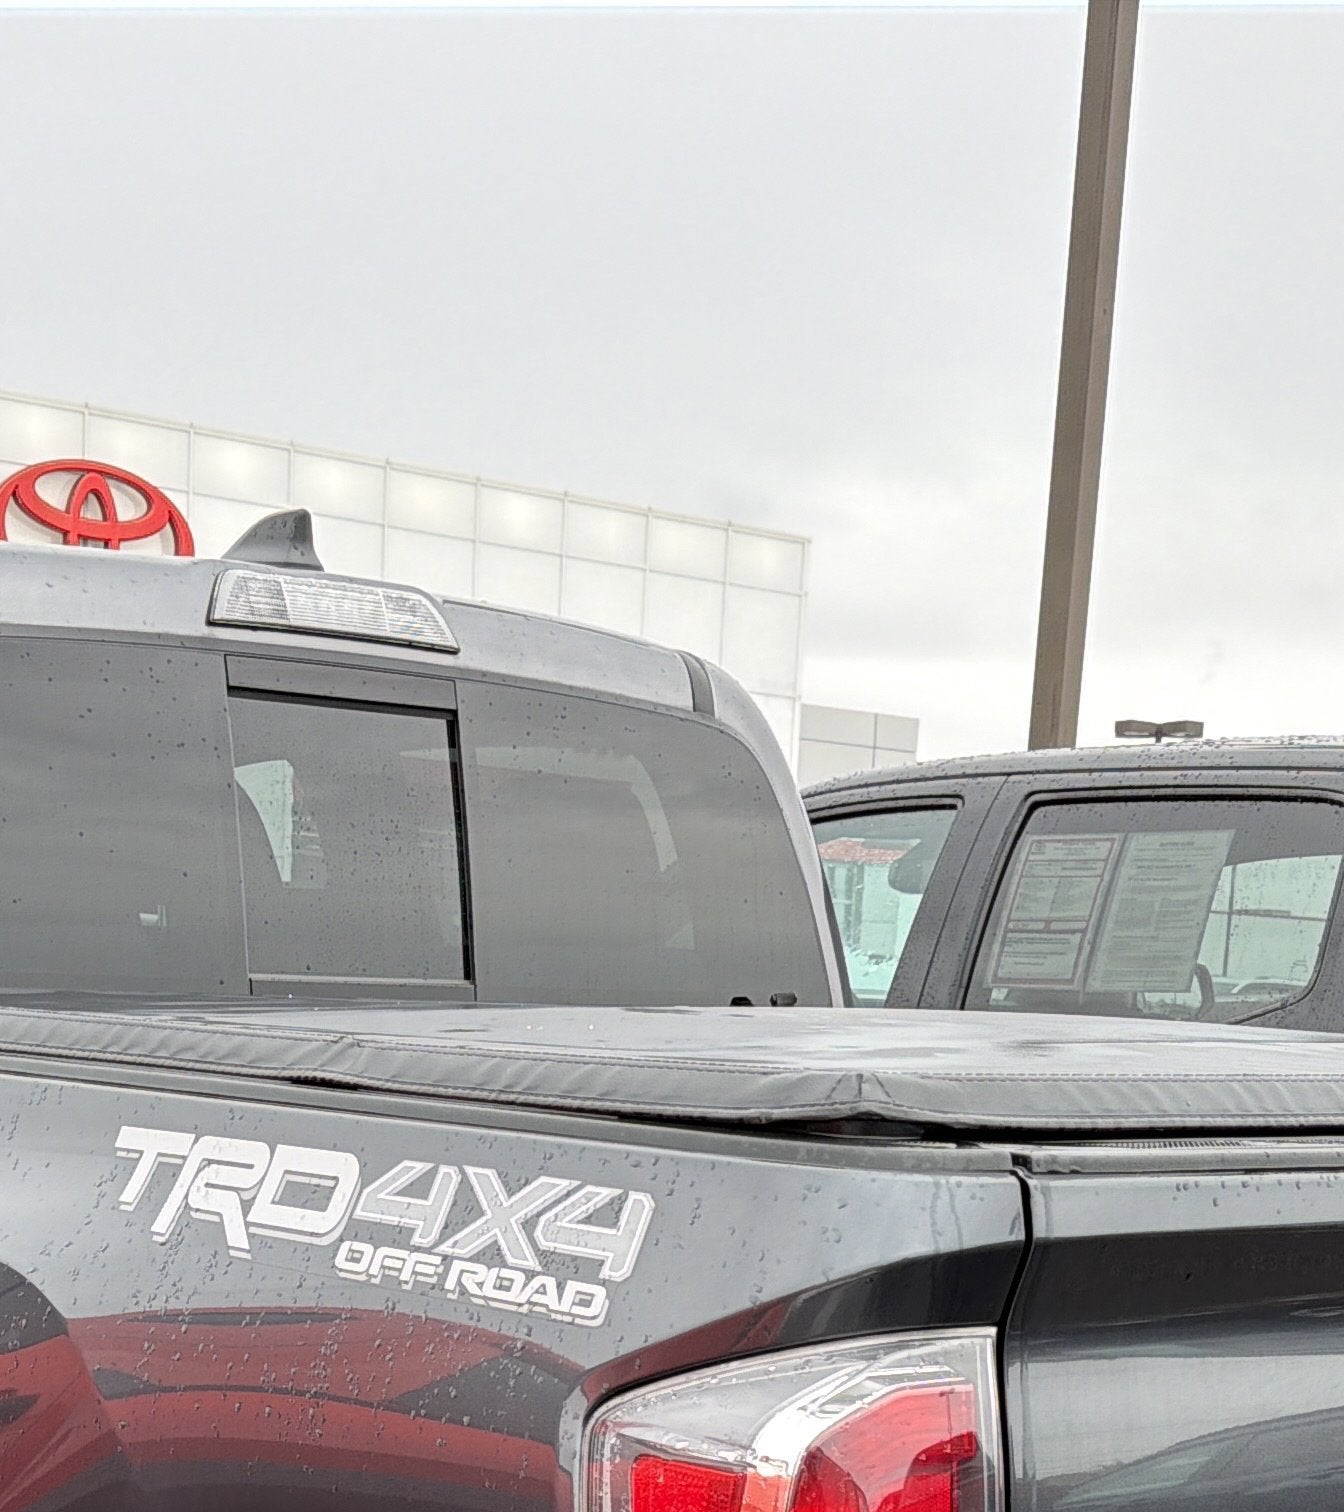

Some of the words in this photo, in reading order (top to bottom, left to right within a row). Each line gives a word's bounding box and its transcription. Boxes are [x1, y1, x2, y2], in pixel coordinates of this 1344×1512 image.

[114, 1125, 358, 1258] TRD
[334, 1240, 442, 1290] OFF
[444, 1259, 611, 1328] ROAD
